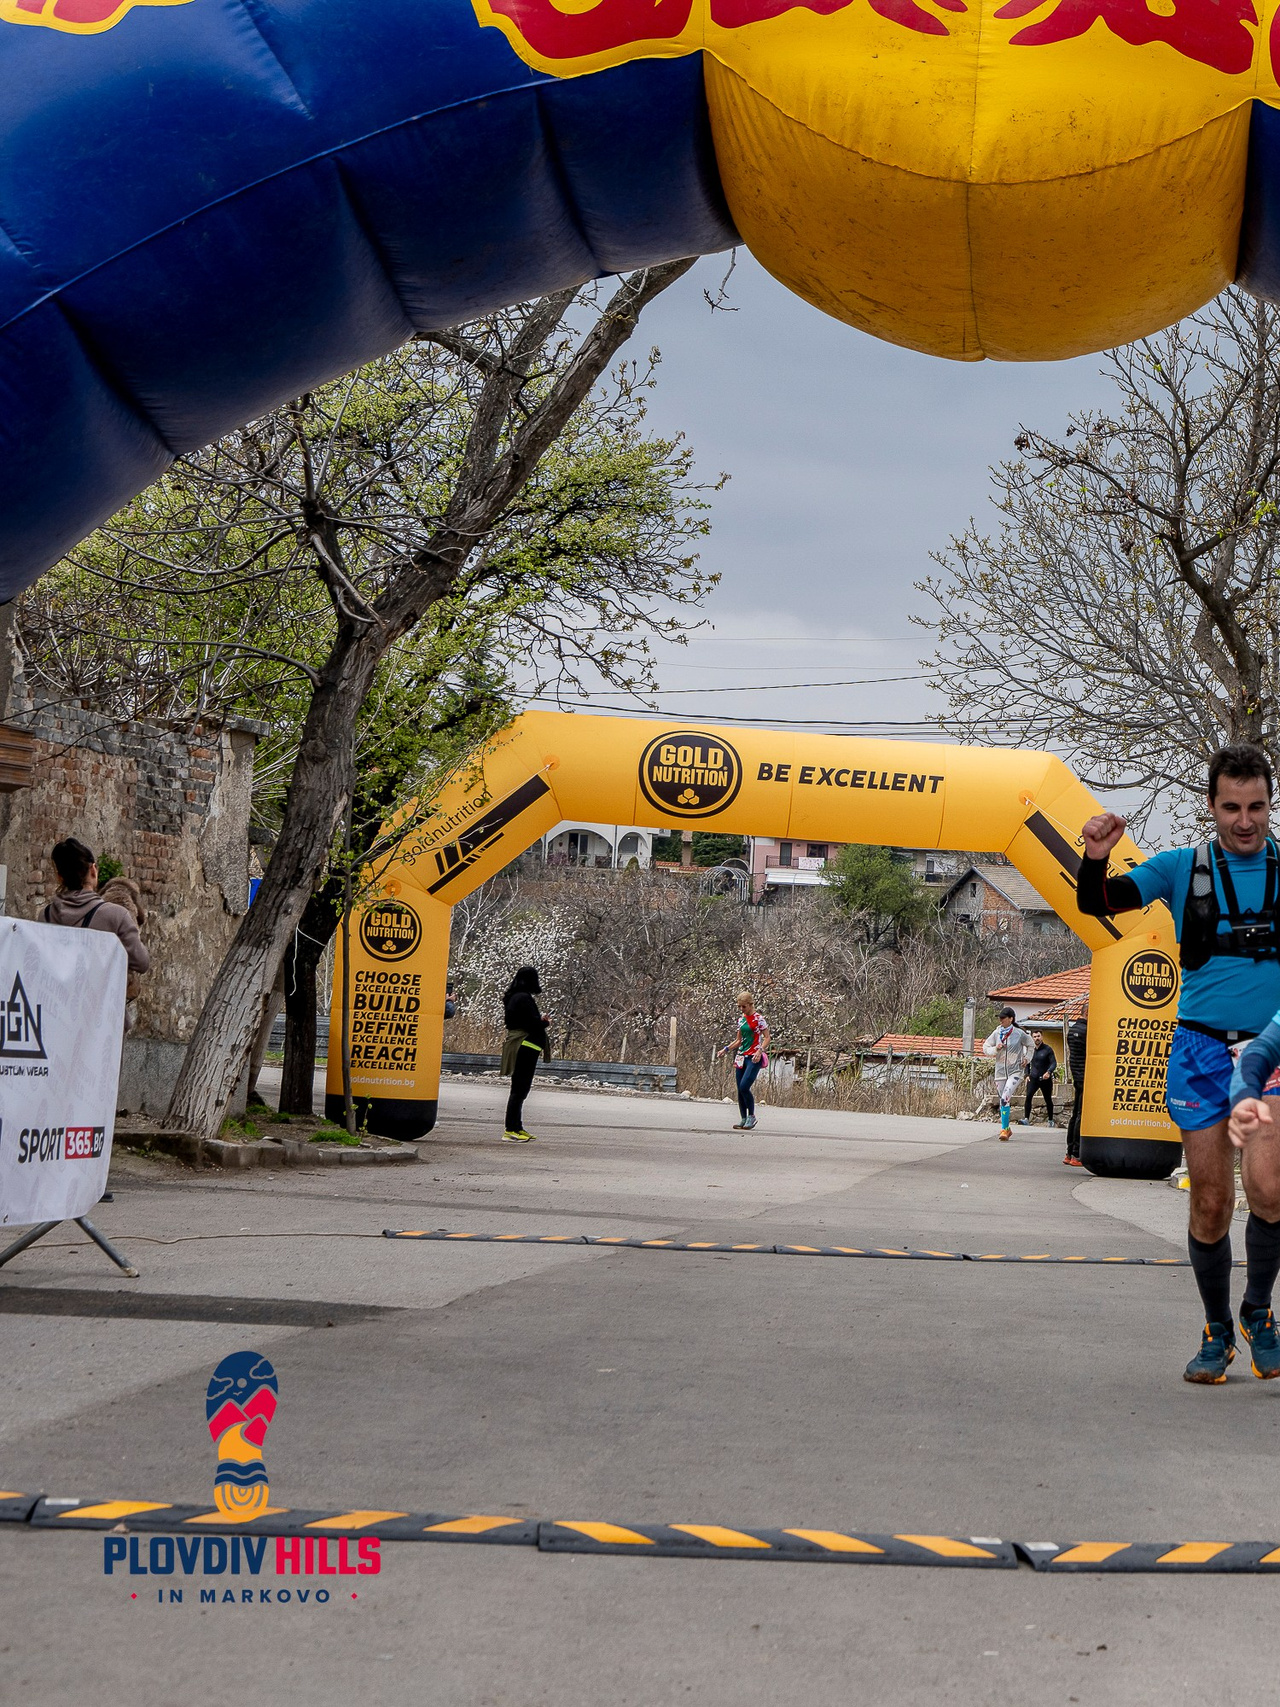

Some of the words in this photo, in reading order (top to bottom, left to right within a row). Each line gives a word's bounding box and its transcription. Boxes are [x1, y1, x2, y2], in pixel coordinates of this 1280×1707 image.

[660, 744, 724, 769] GOLD
[652, 765, 728, 787] NUTRITION
[757, 762, 791, 782] BE
[798, 765, 944, 794] EXCELLENT
[370, 912, 411, 928] GOLD
[367, 926, 414, 940] NUTRITION
[1133, 962, 1170, 977] GOLD
[355, 970, 422, 986] CHOOSE
[1129, 975, 1172, 988] NUTRITION
[354, 984, 420, 996] EXCELLENCE
[353, 993, 420, 1013] BUILD
[353, 1011, 419, 1023] EXCELLENCE
[352, 1021, 418, 1037] DEFINE
[351, 1034, 418, 1046] EXCELLENCE
[1117, 1031, 1174, 1042] EXCELLENC
[351, 1045, 417, 1062] REACH
[26, 1066, 49, 1077] WEAR
[350, 1060, 416, 1071] EXCELLENCE
[1114, 1065, 1168, 1080] DEFIN
[1112, 1103, 1169, 1114] EXCELLENC
[1110, 1118, 1171, 1129] goldnutrition.bg
